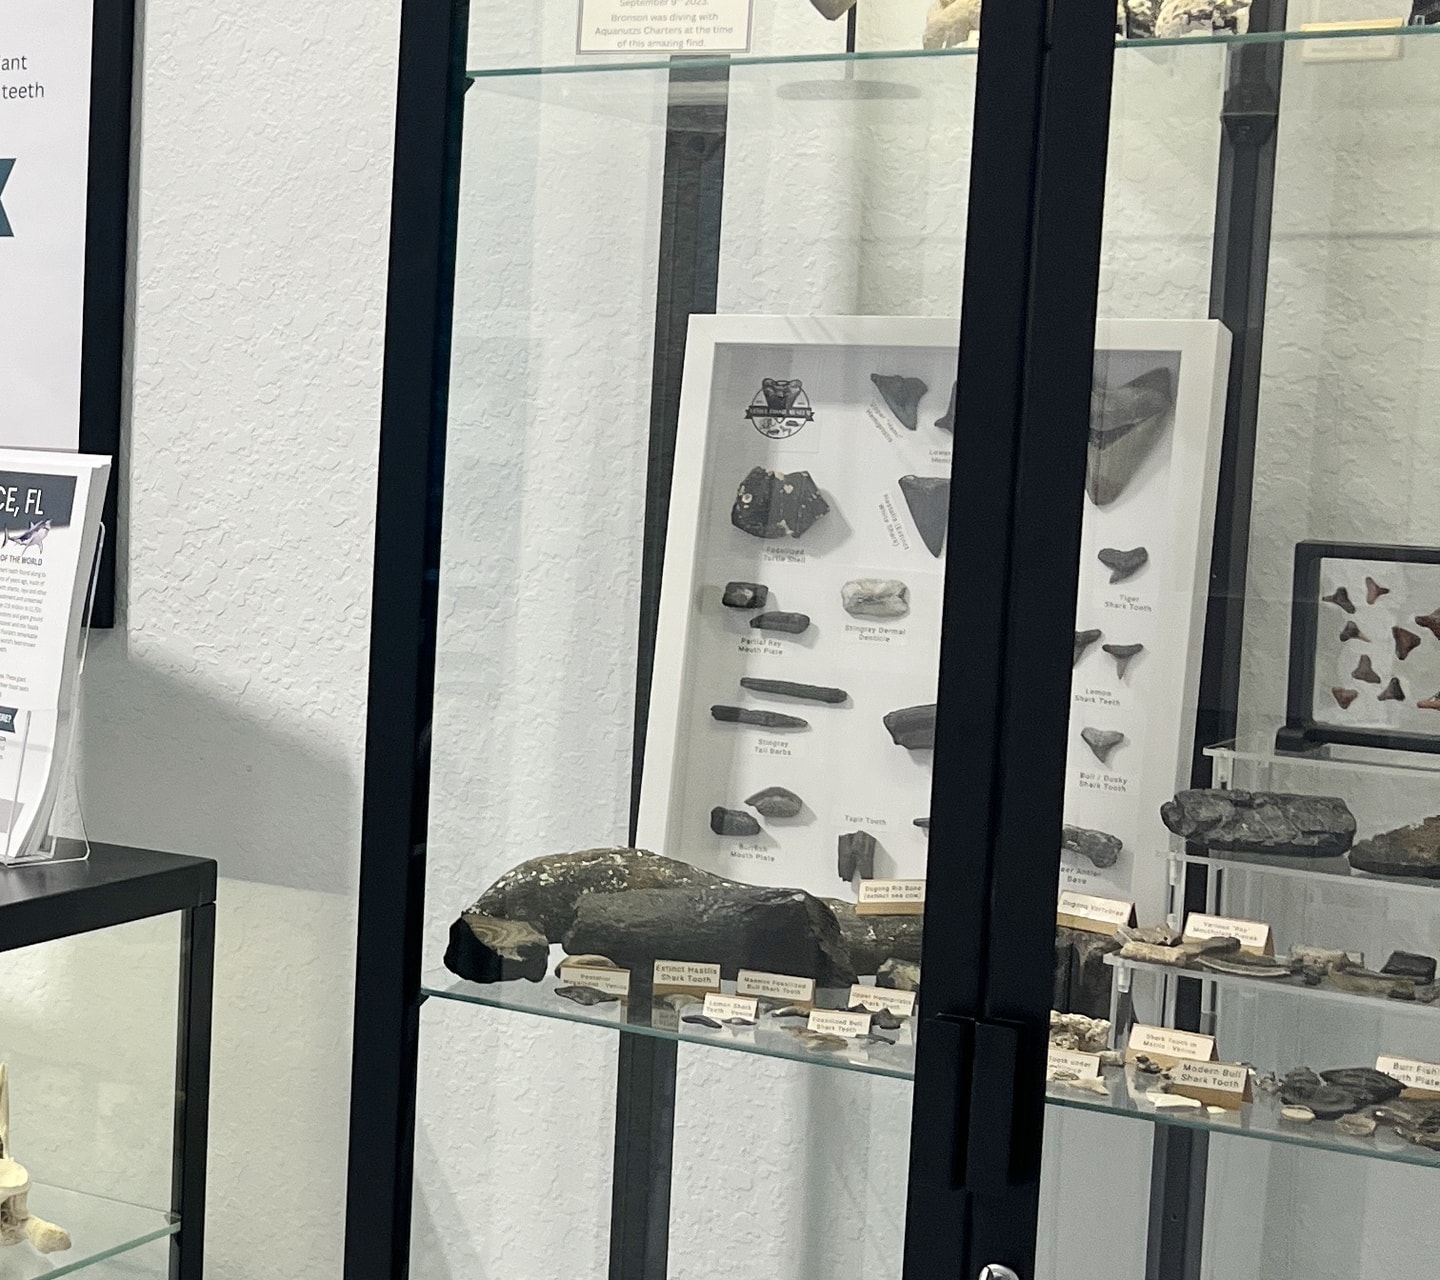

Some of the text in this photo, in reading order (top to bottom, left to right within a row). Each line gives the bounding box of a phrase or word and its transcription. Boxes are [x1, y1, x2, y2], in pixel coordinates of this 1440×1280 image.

[24, 488, 45, 517] FL
[1182, 1063, 1243, 1079] Modern Bull
[1180, 1073, 1240, 1089] Shark Tooth
